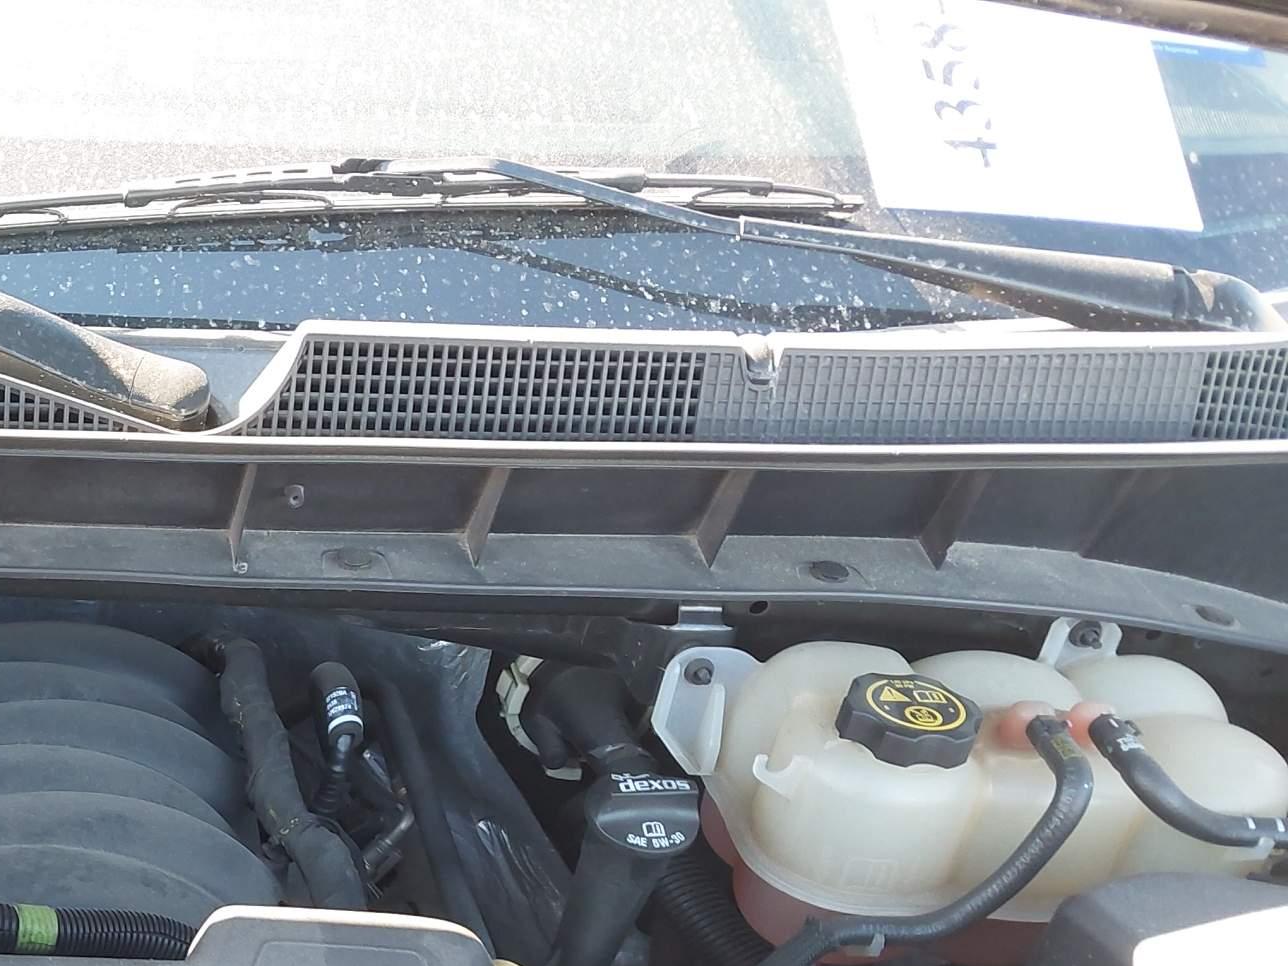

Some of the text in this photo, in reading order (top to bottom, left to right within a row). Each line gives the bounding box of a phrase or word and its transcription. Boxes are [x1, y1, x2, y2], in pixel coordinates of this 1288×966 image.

[912, 0, 998, 168] 4358
[619, 779, 690, 793] dexos
[626, 833, 648, 848] SAE
